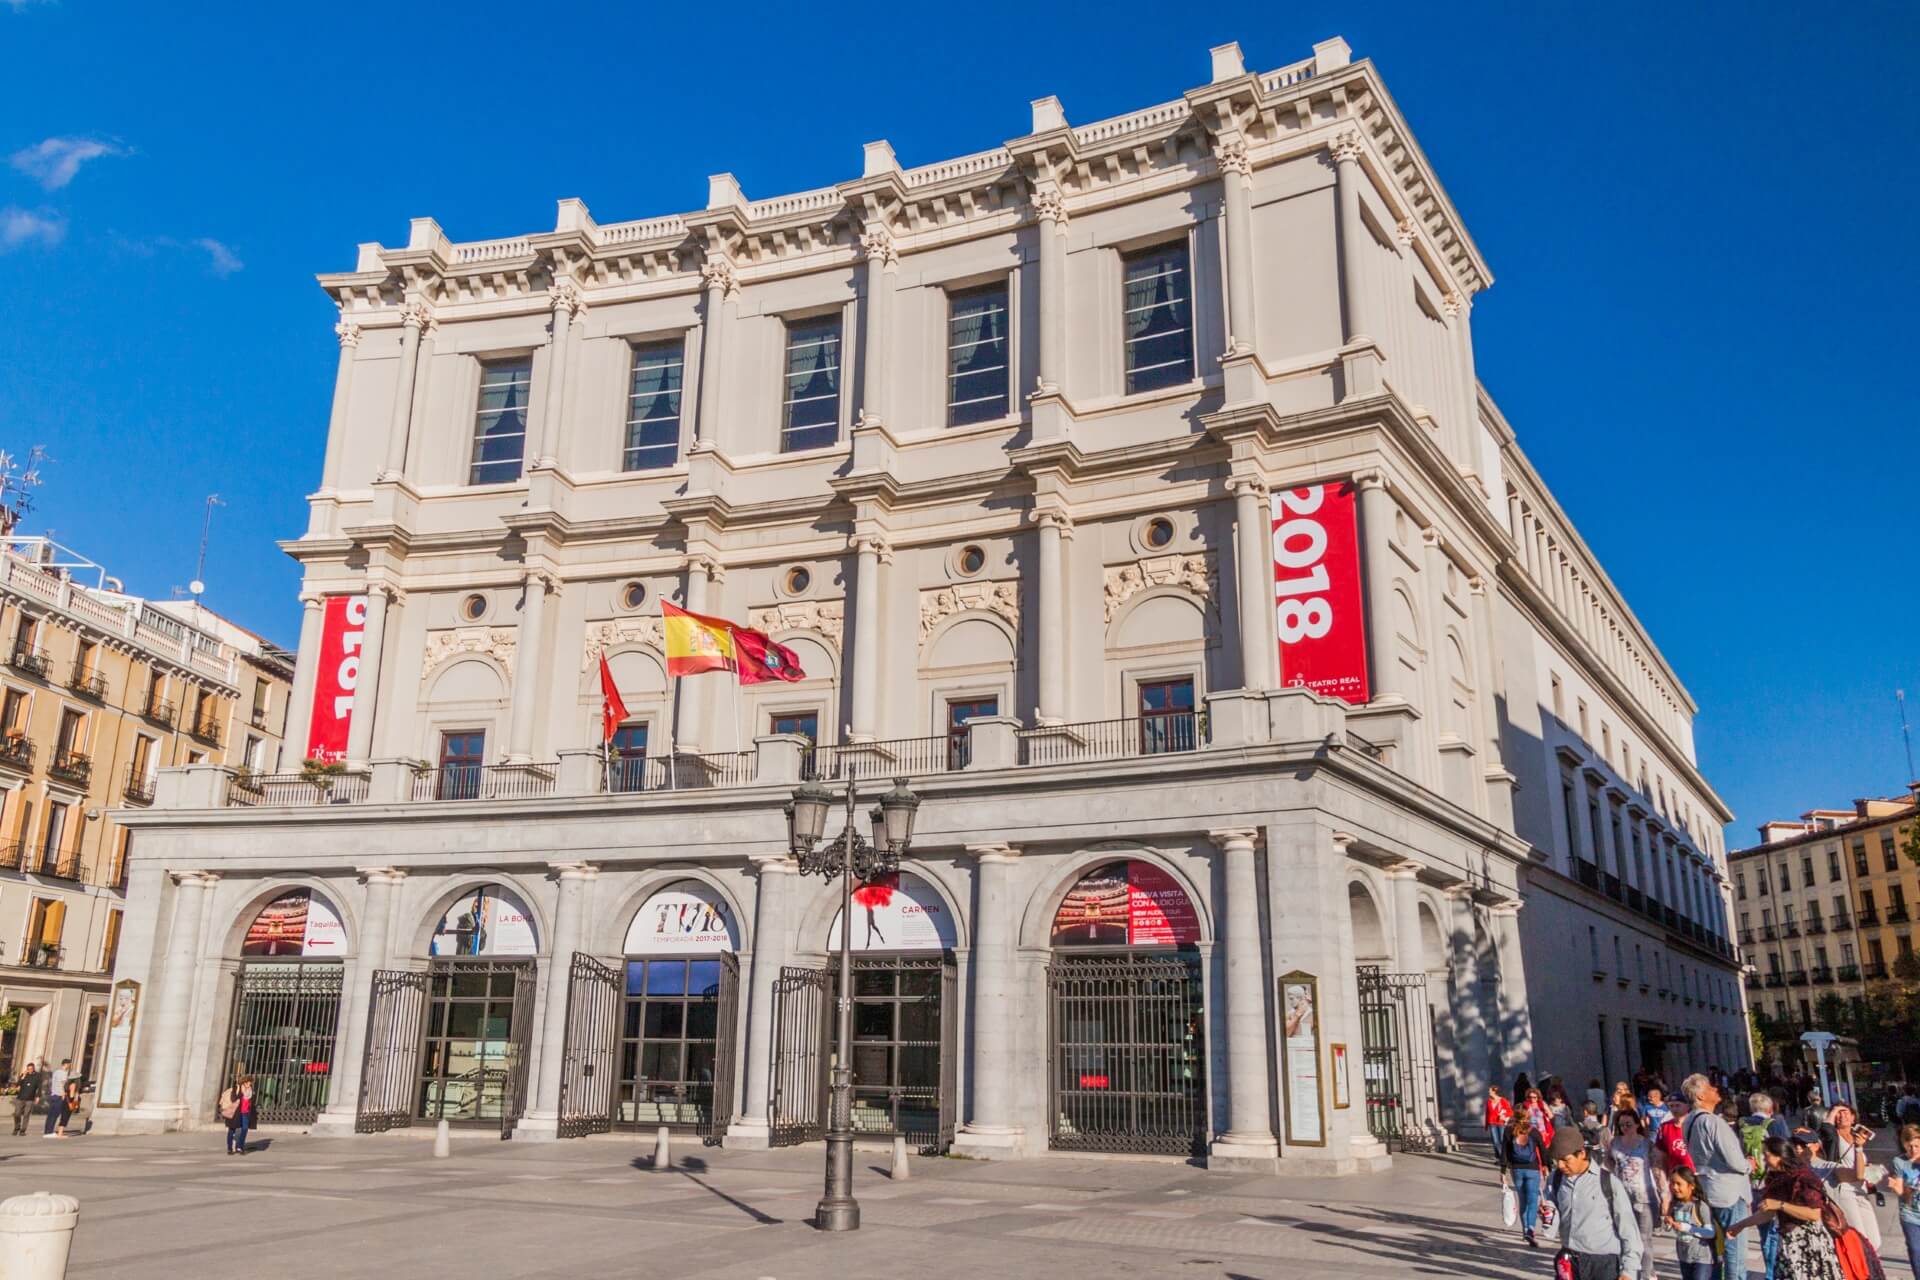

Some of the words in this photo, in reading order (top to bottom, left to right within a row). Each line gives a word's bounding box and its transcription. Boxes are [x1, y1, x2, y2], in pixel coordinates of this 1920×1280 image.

[1271, 485, 1333, 644] 2018
[1307, 679, 1337, 688] TEATRO
[1340, 676, 1360, 684] REAL
[1150, 899, 1174, 907] AUDIO
[902, 905, 939, 913] CARMEN
